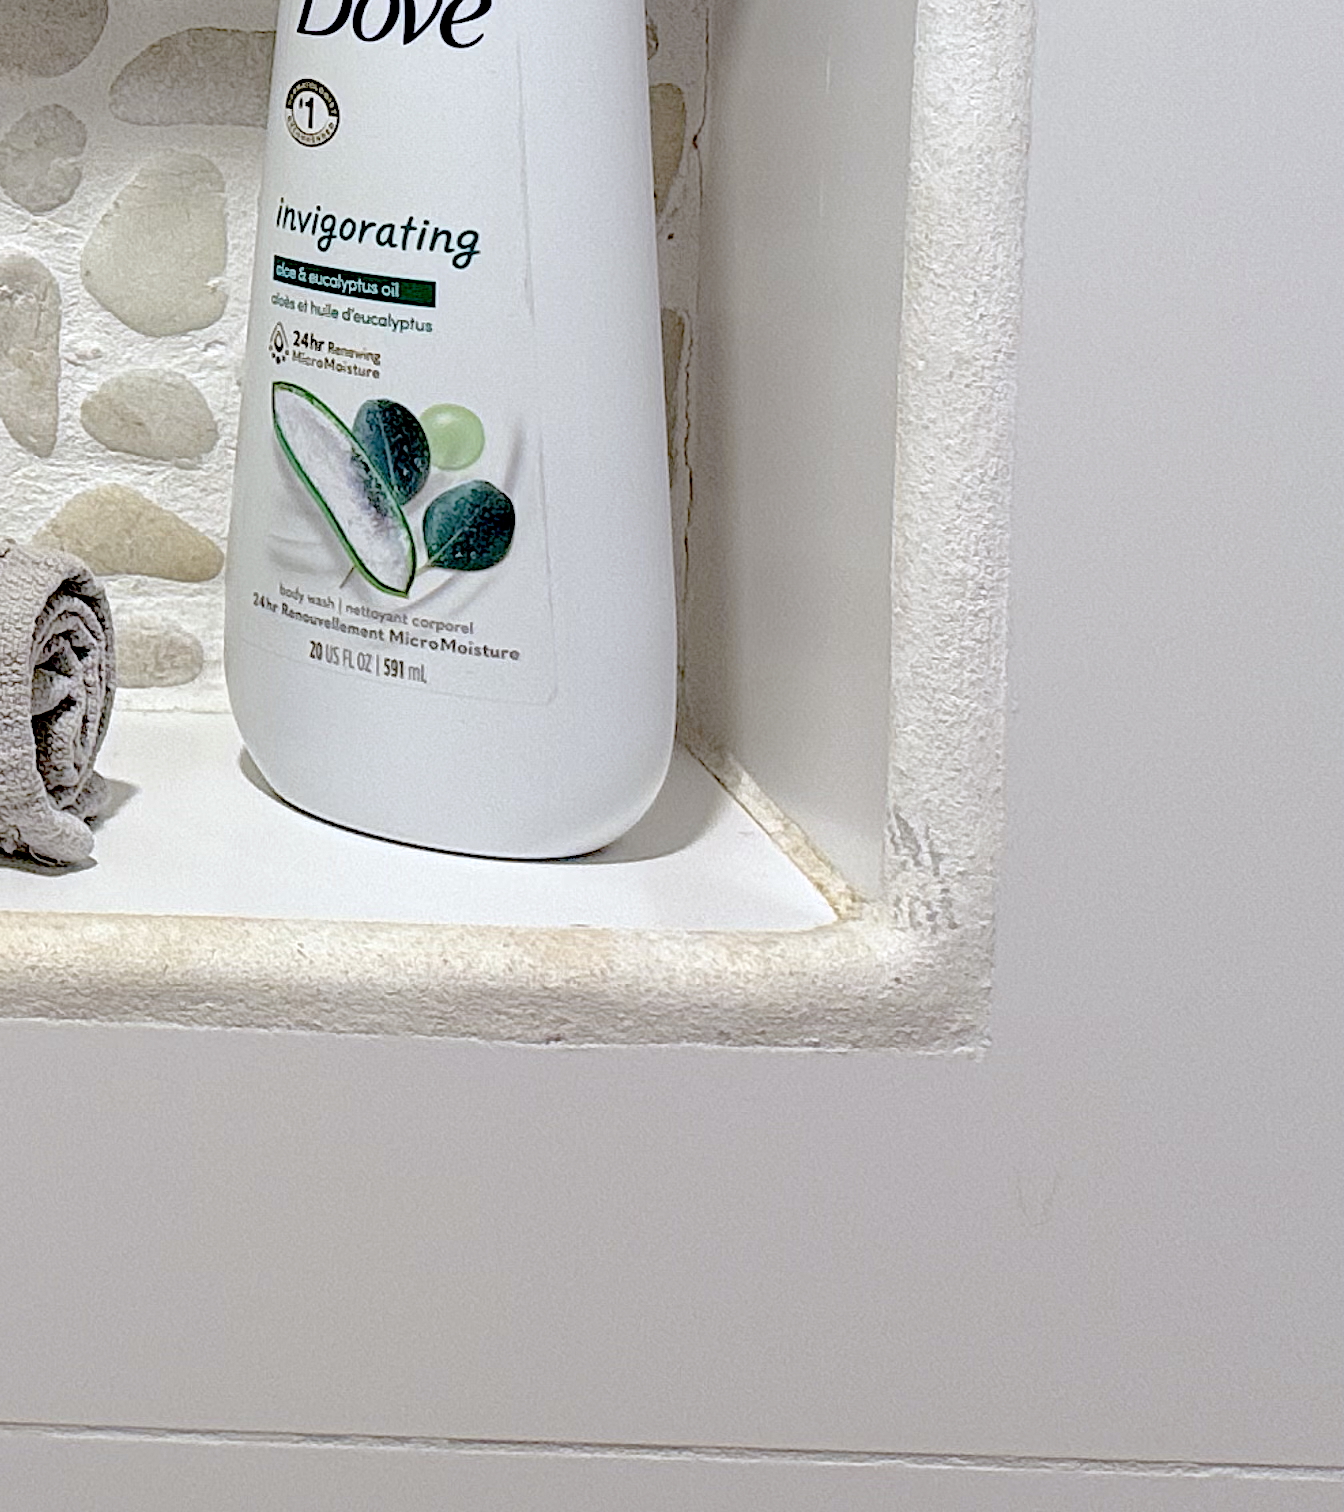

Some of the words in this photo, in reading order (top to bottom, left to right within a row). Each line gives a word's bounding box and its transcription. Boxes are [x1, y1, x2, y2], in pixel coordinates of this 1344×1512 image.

[276, 197, 481, 269] invigorating
[308, 271, 378, 296] eucalyptus
[381, 282, 400, 298] oil
[341, 307, 433, 333] d'eucalyptus
[279, 581, 305, 604] body
[345, 604, 409, 626] nettoyant
[411, 615, 474, 635] corporel
[281, 602, 385, 641] Renouvellement
[389, 629, 521, 661] MicroMoisture
[309, 640, 323, 660] 20
[325, 645, 340, 666] US
[342, 649, 355, 669] FL
[356, 652, 372, 673] OZ
[383, 657, 405, 679] 591
